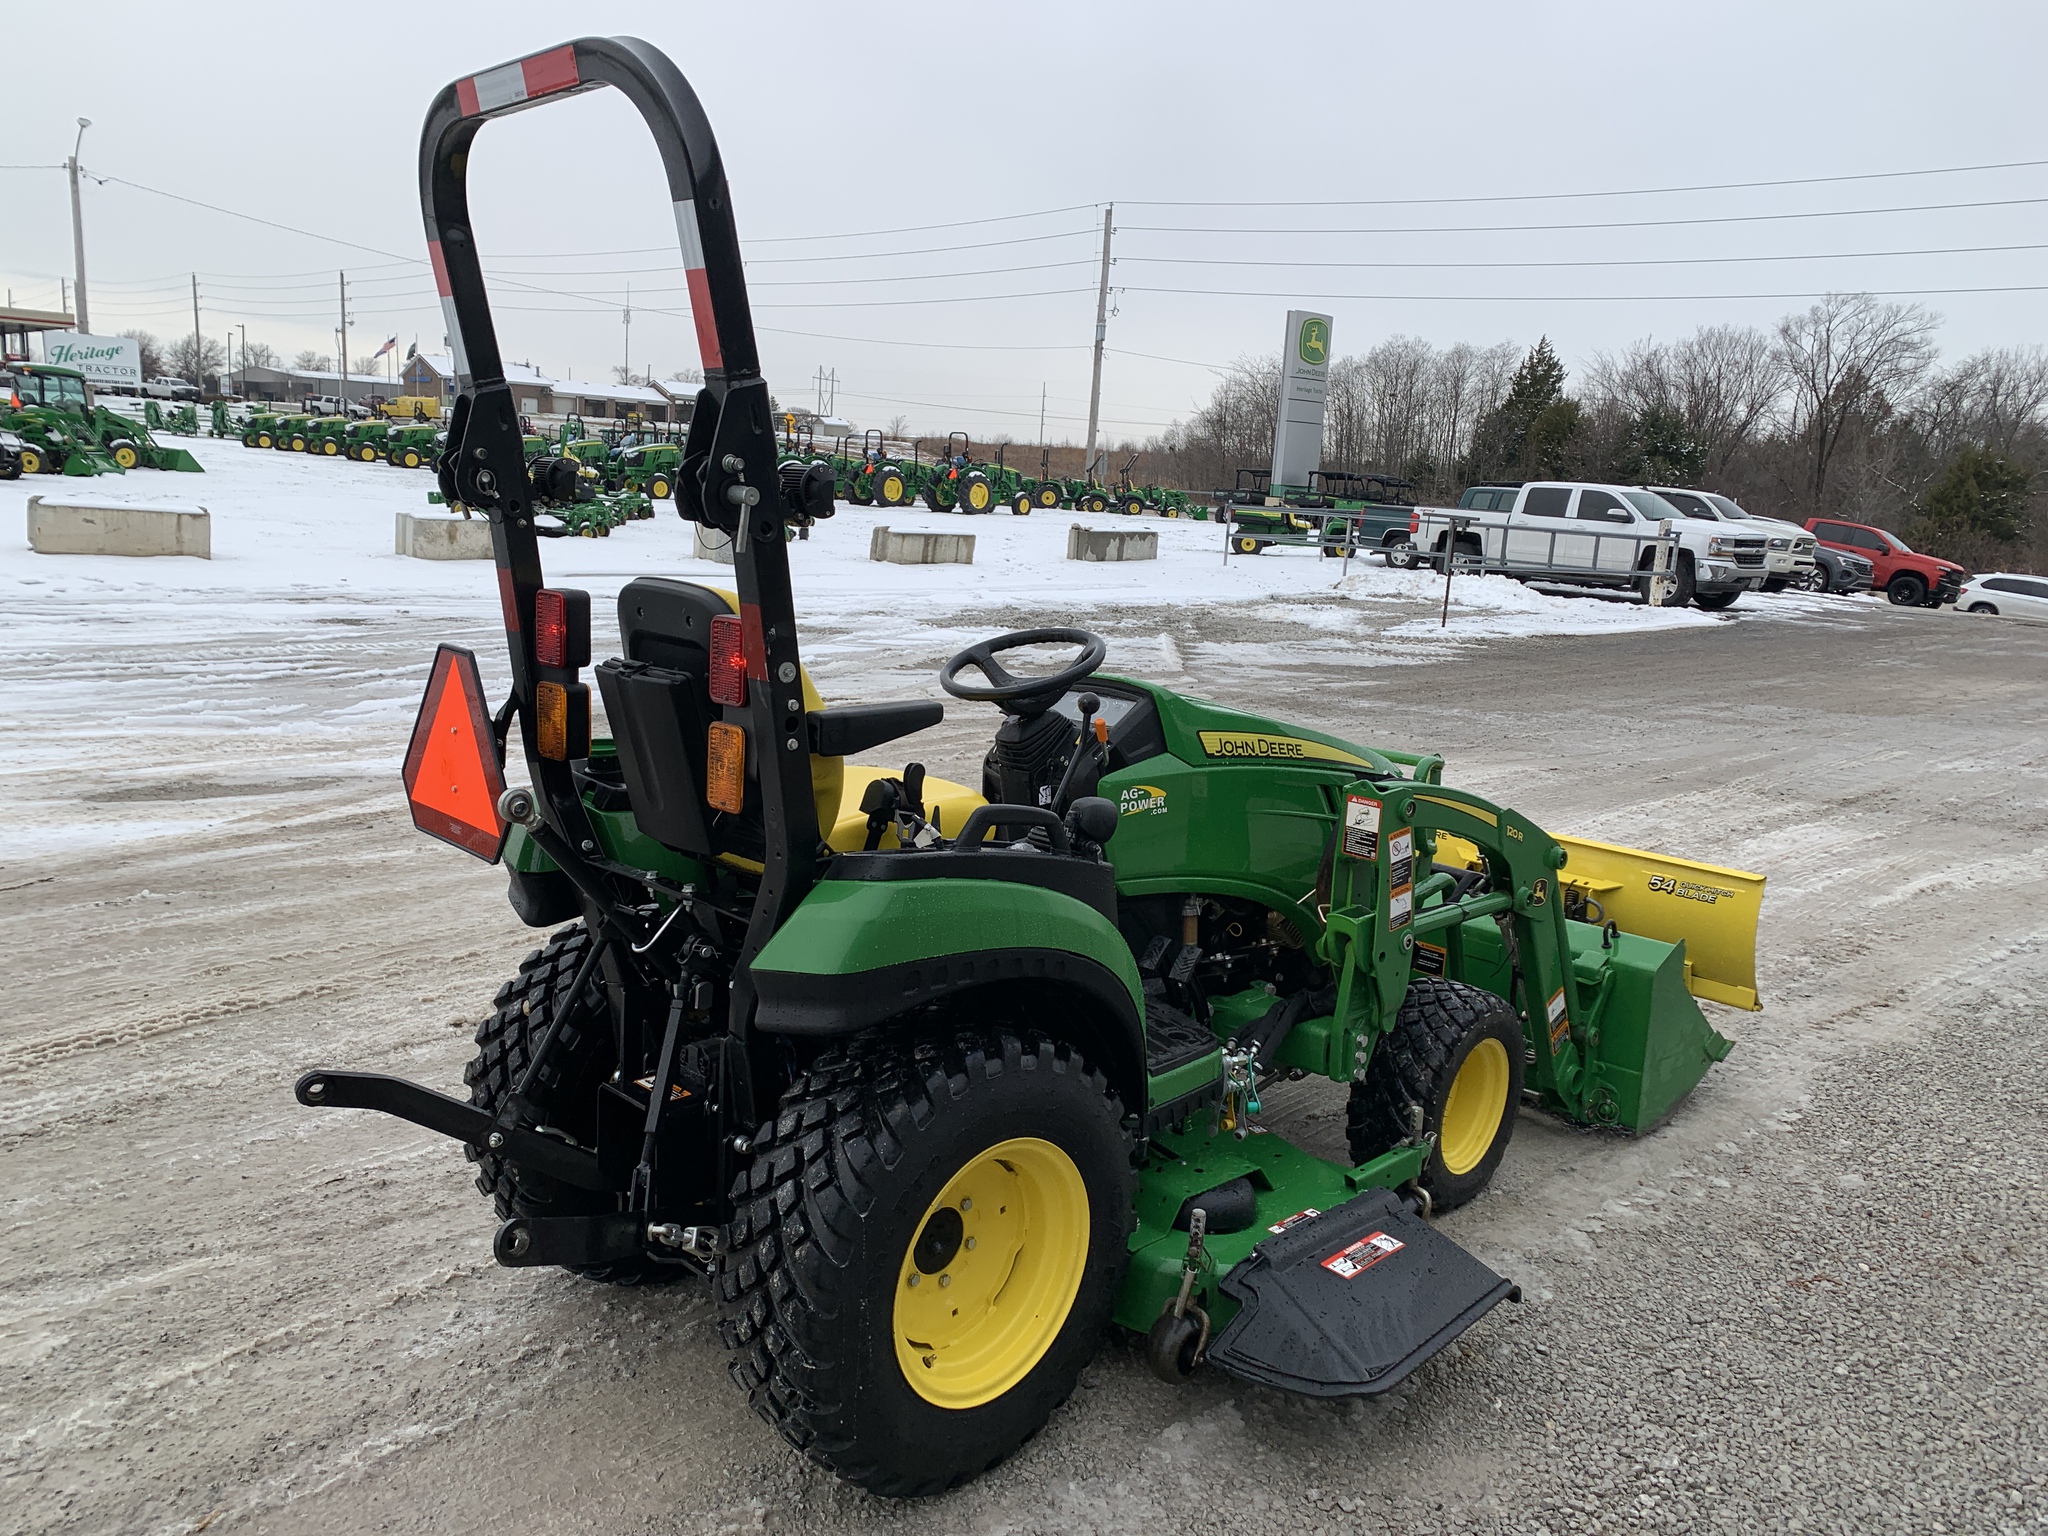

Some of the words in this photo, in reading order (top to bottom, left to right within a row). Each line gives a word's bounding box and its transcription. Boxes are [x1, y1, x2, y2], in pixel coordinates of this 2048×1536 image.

[49, 342, 123, 366] Heritage
[78, 364, 137, 376] TRACTOR
[1296, 367, 1311, 375] JOHN
[1216, 738, 1254, 754] JOHN
[1258, 739, 1304, 757] DEERE
[1121, 789, 1144, 800] AG-
[1120, 797, 1165, 814] POWER
[1150, 807, 1168, 816] .COM
[1648, 875, 1677, 895] 54
[1680, 881, 1706, 892] QUICK
[1675, 888, 1717, 904] BLADE
